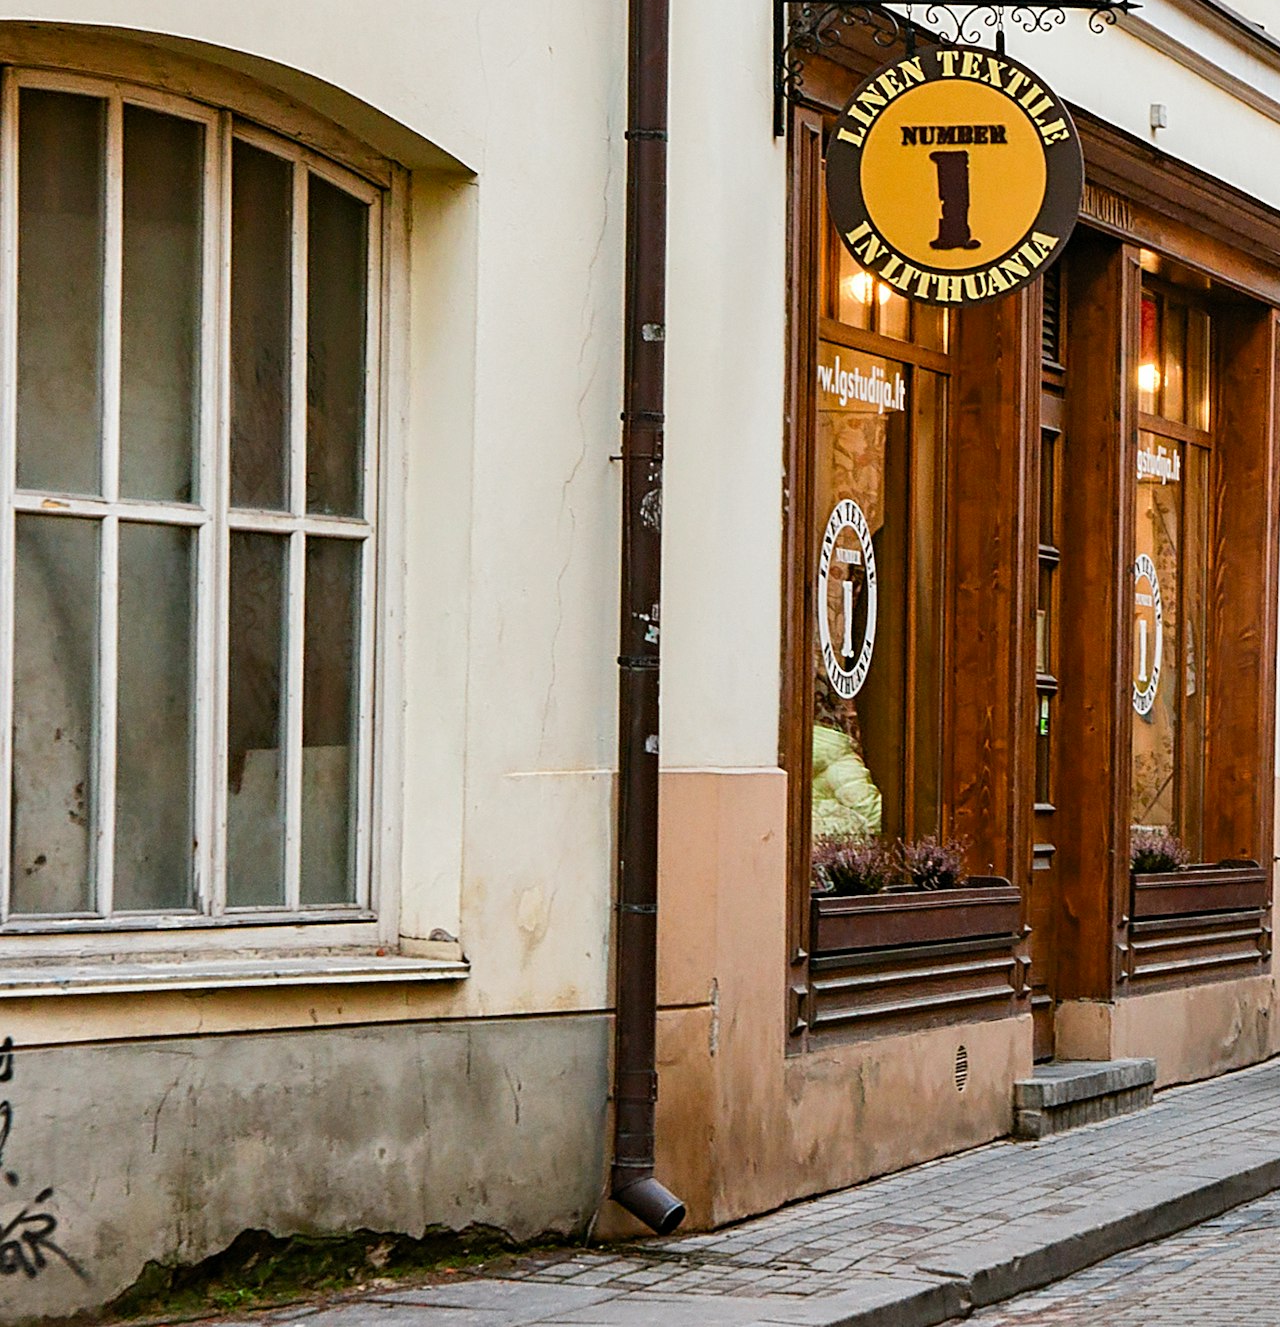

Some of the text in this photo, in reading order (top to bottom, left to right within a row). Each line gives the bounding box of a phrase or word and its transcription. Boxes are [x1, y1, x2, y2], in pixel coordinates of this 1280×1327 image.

[837, 50, 1070, 148] LINEN TEXTILE
[900, 125, 1007, 146] NUMBER
[929, 150, 981, 250] 1
[846, 220, 1060, 303] IN LITHUANIA
